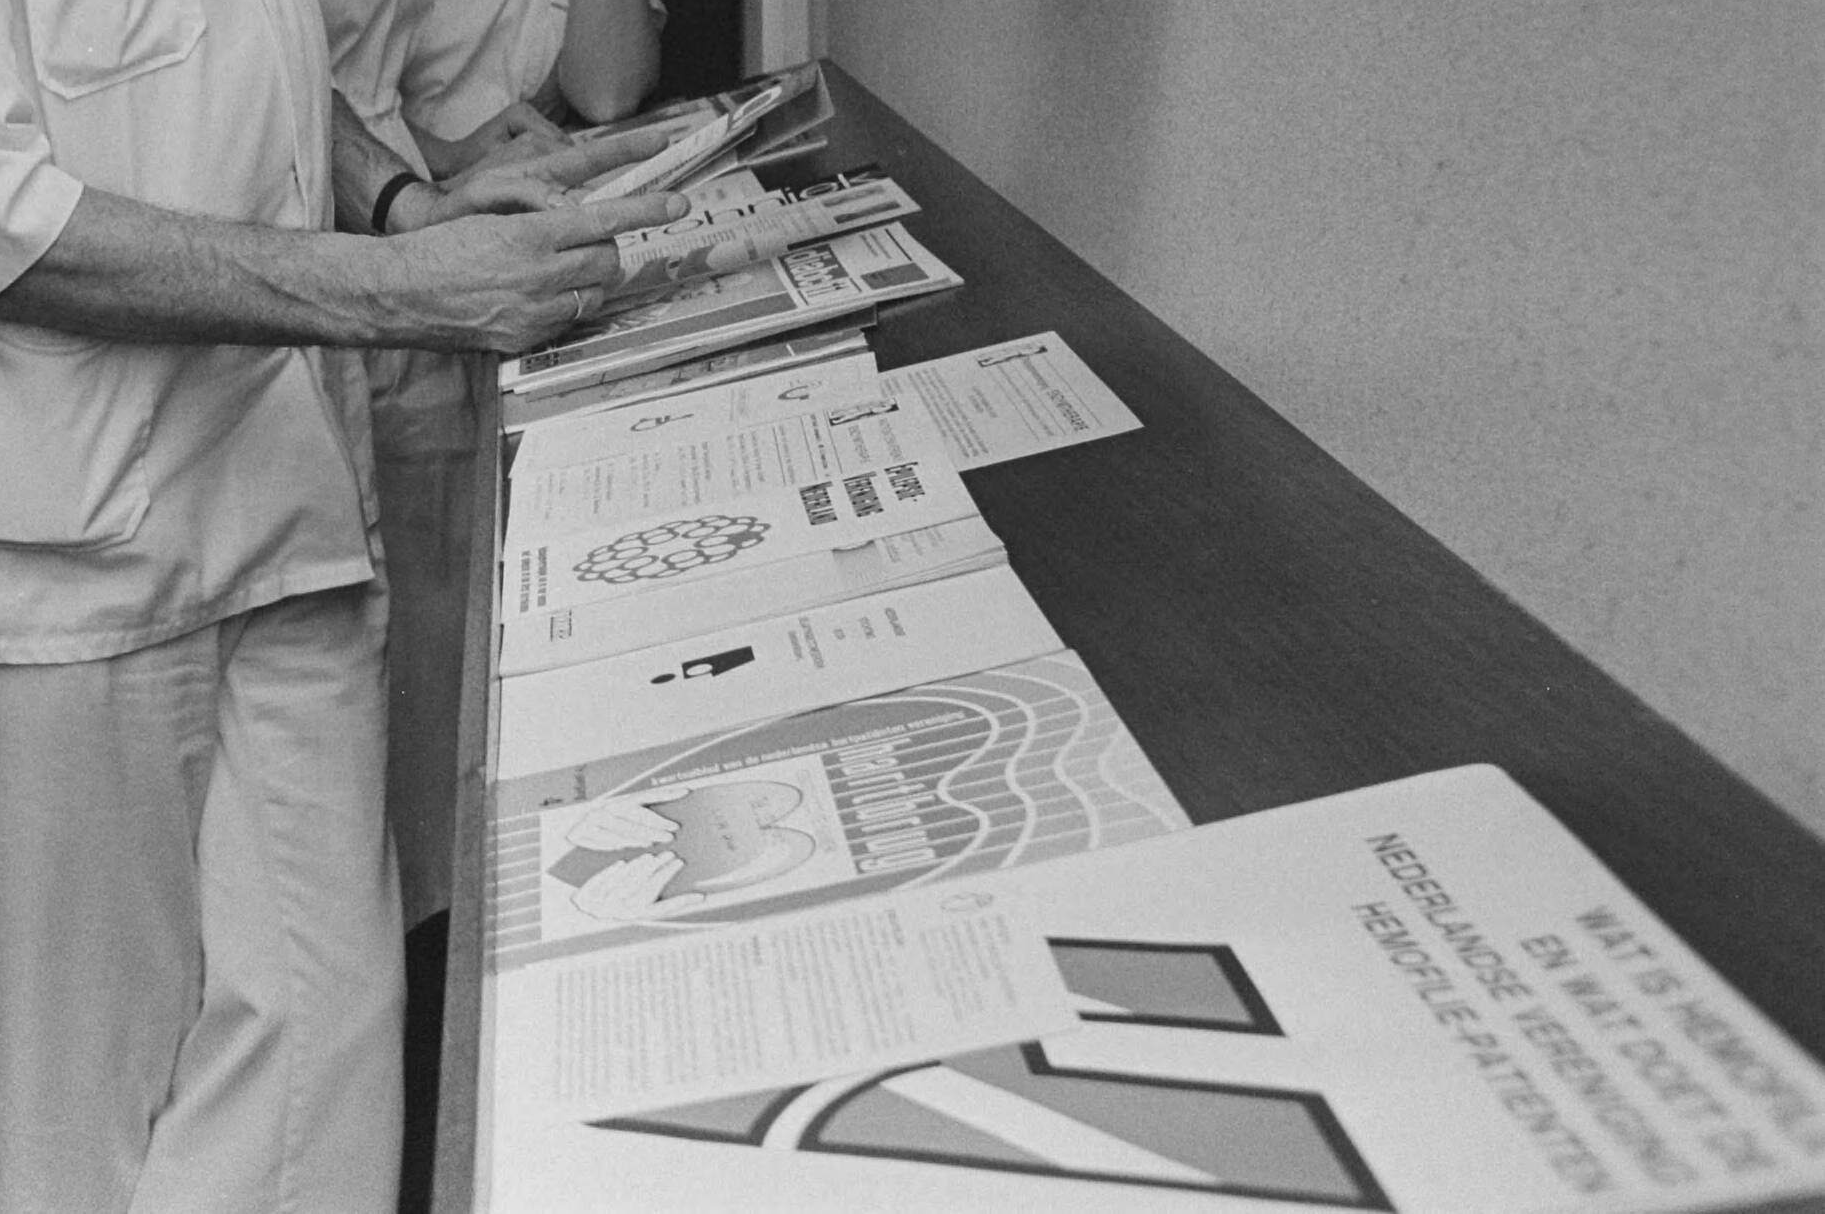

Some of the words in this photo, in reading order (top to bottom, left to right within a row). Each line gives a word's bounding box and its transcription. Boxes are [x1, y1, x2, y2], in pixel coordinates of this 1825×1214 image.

[837, 736, 937, 873] hartbrug
[1367, 831, 1536, 1002] NEDERLANDSE
[1575, 904, 1658, 963] WAT
[1634, 967, 1684, 997] IS
[1520, 933, 1578, 972] EN
[1561, 973, 1644, 1033] WAT
